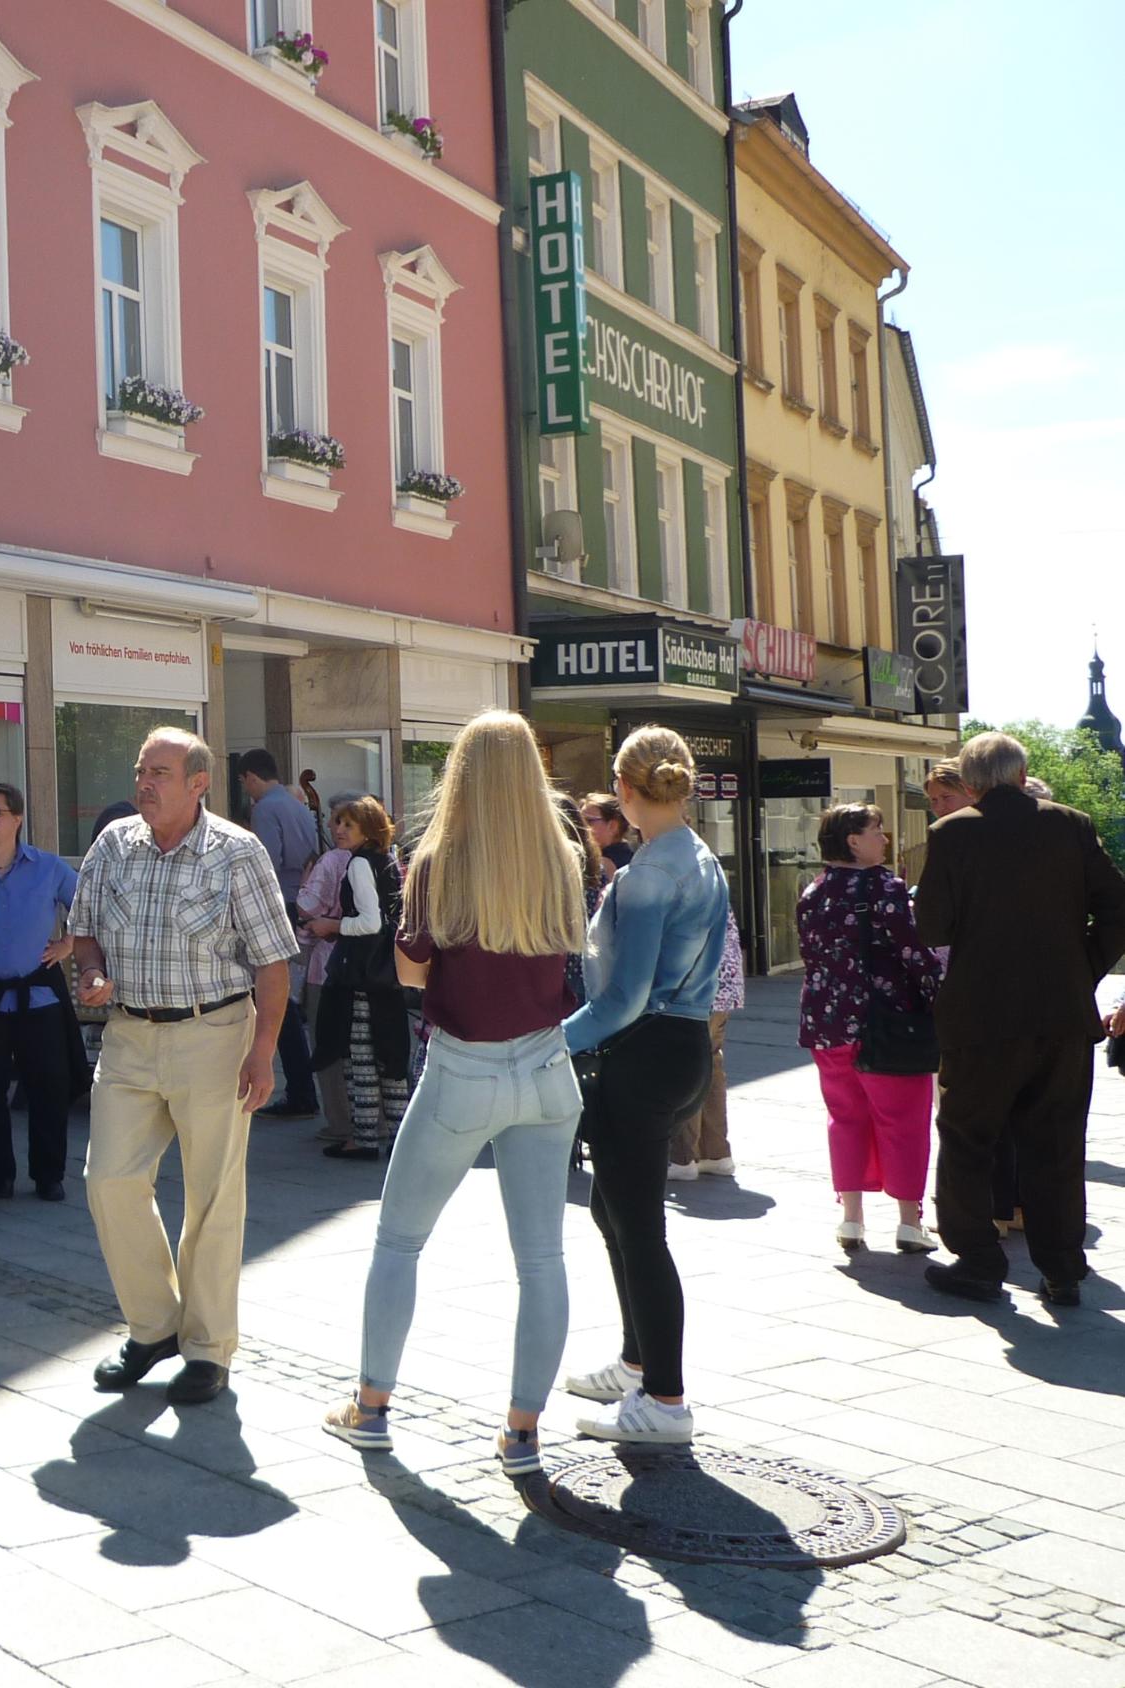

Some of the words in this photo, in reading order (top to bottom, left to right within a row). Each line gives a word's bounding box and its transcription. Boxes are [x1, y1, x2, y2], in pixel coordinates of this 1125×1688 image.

[536, 181, 573, 425] HOTEL
[571, 184, 590, 425] HOTEL
[673, 363, 707, 429] HOF
[69, 641, 84, 655] Von
[86, 641, 123, 658] fröhlichen
[124, 647, 153, 661] Familien
[154, 651, 192, 665] empfohlen.
[557, 639, 654, 675] HOTEL
[665, 635, 717, 672] Sächsischer
[719, 645, 735, 675] Hof
[743, 619, 817, 682] SCHILLER
